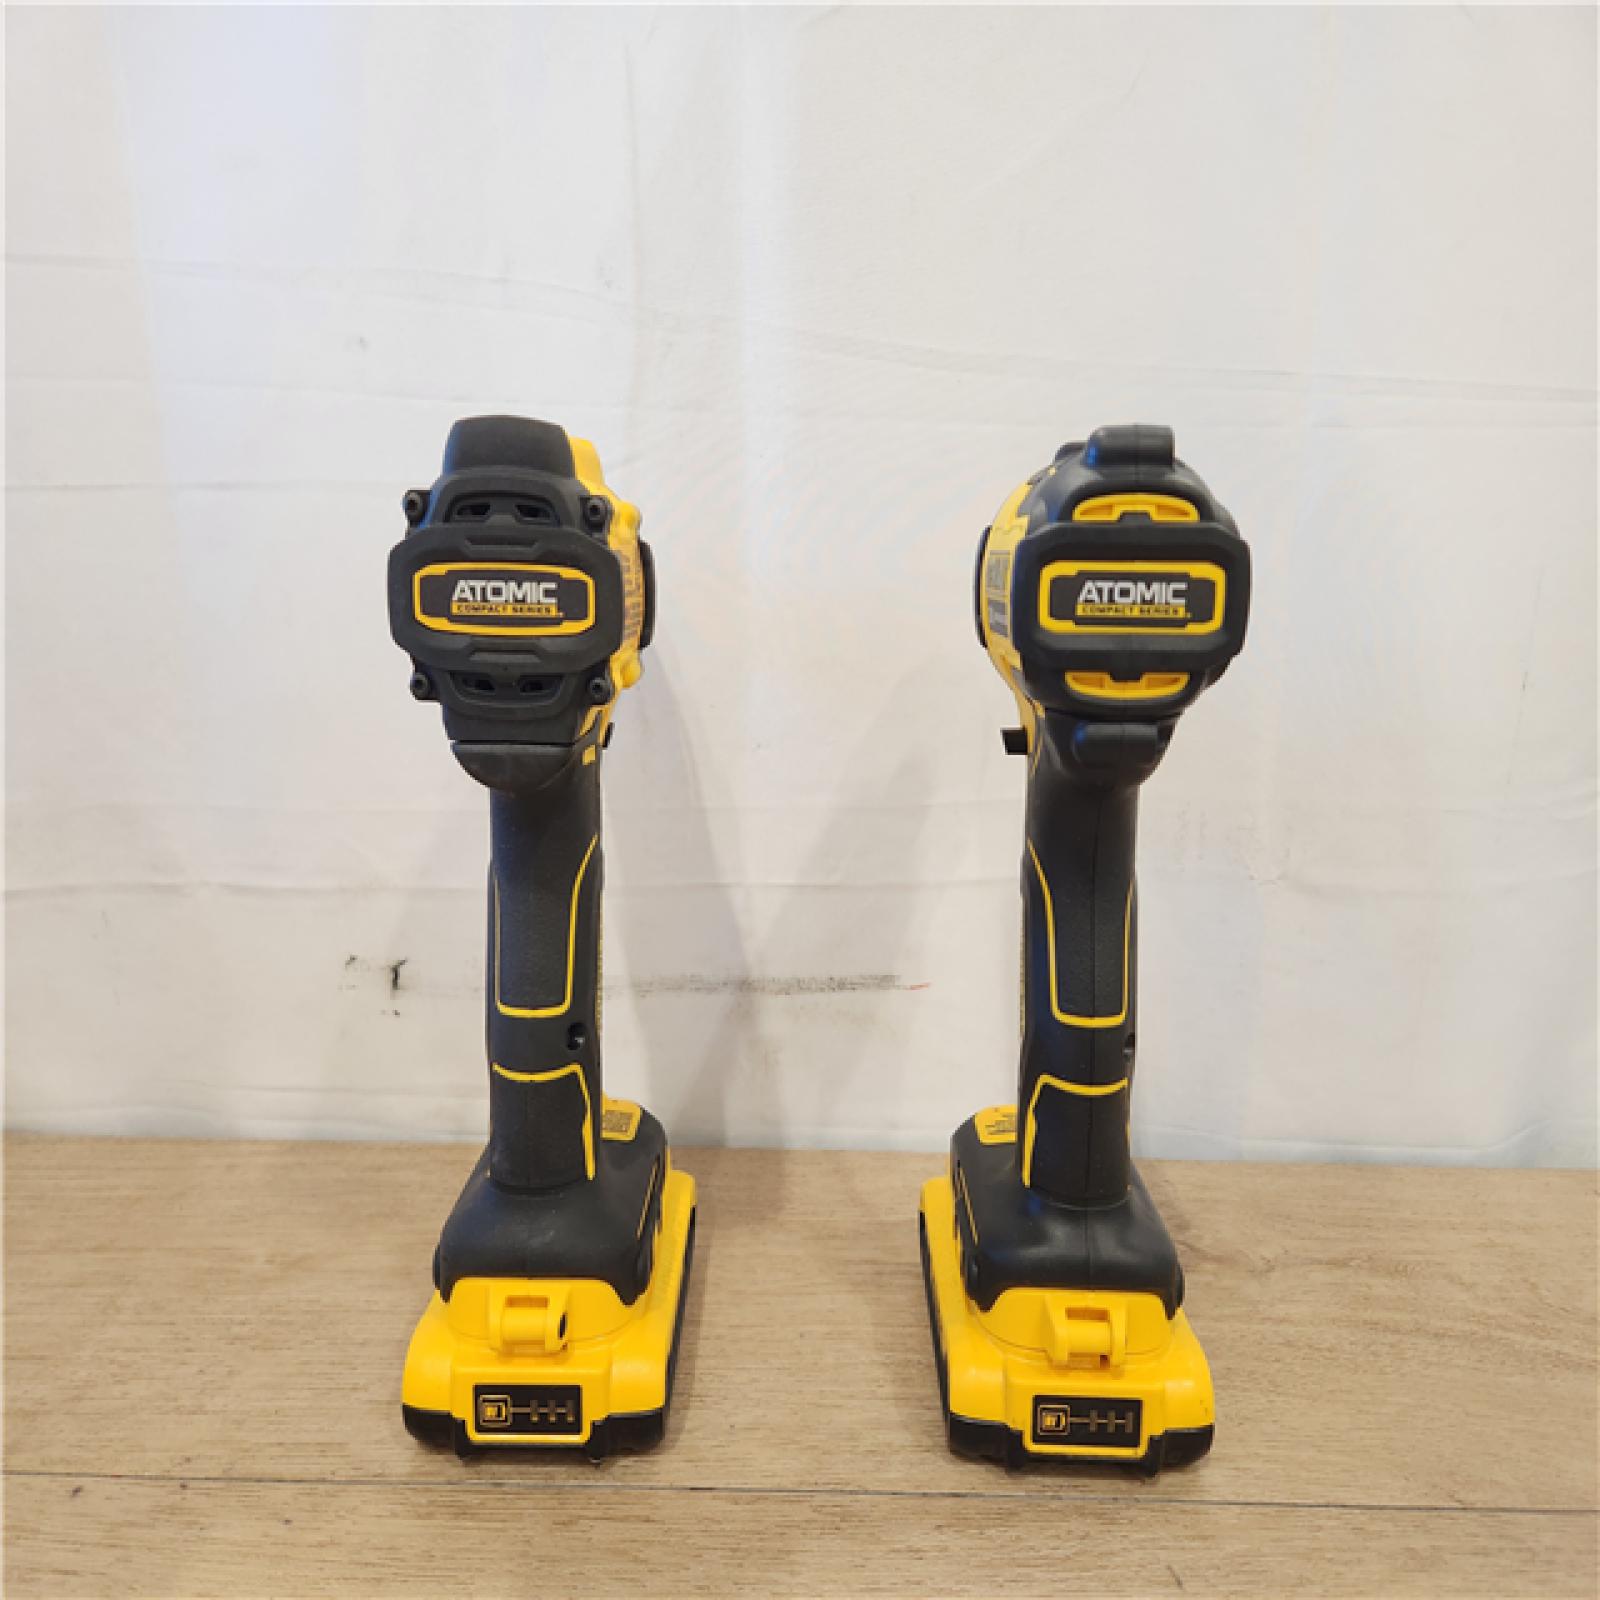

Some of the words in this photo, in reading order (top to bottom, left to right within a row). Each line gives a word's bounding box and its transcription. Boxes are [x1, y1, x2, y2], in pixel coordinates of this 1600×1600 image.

[452, 579, 557, 604] ATOMIC
[1078, 579, 1188, 605] ATOMIC
[456, 604, 508, 614] COMPACT
[512, 605, 551, 615] SERIES
[1082, 606, 1134, 615] COMPACT
[1139, 606, 1179, 616] SERIES
